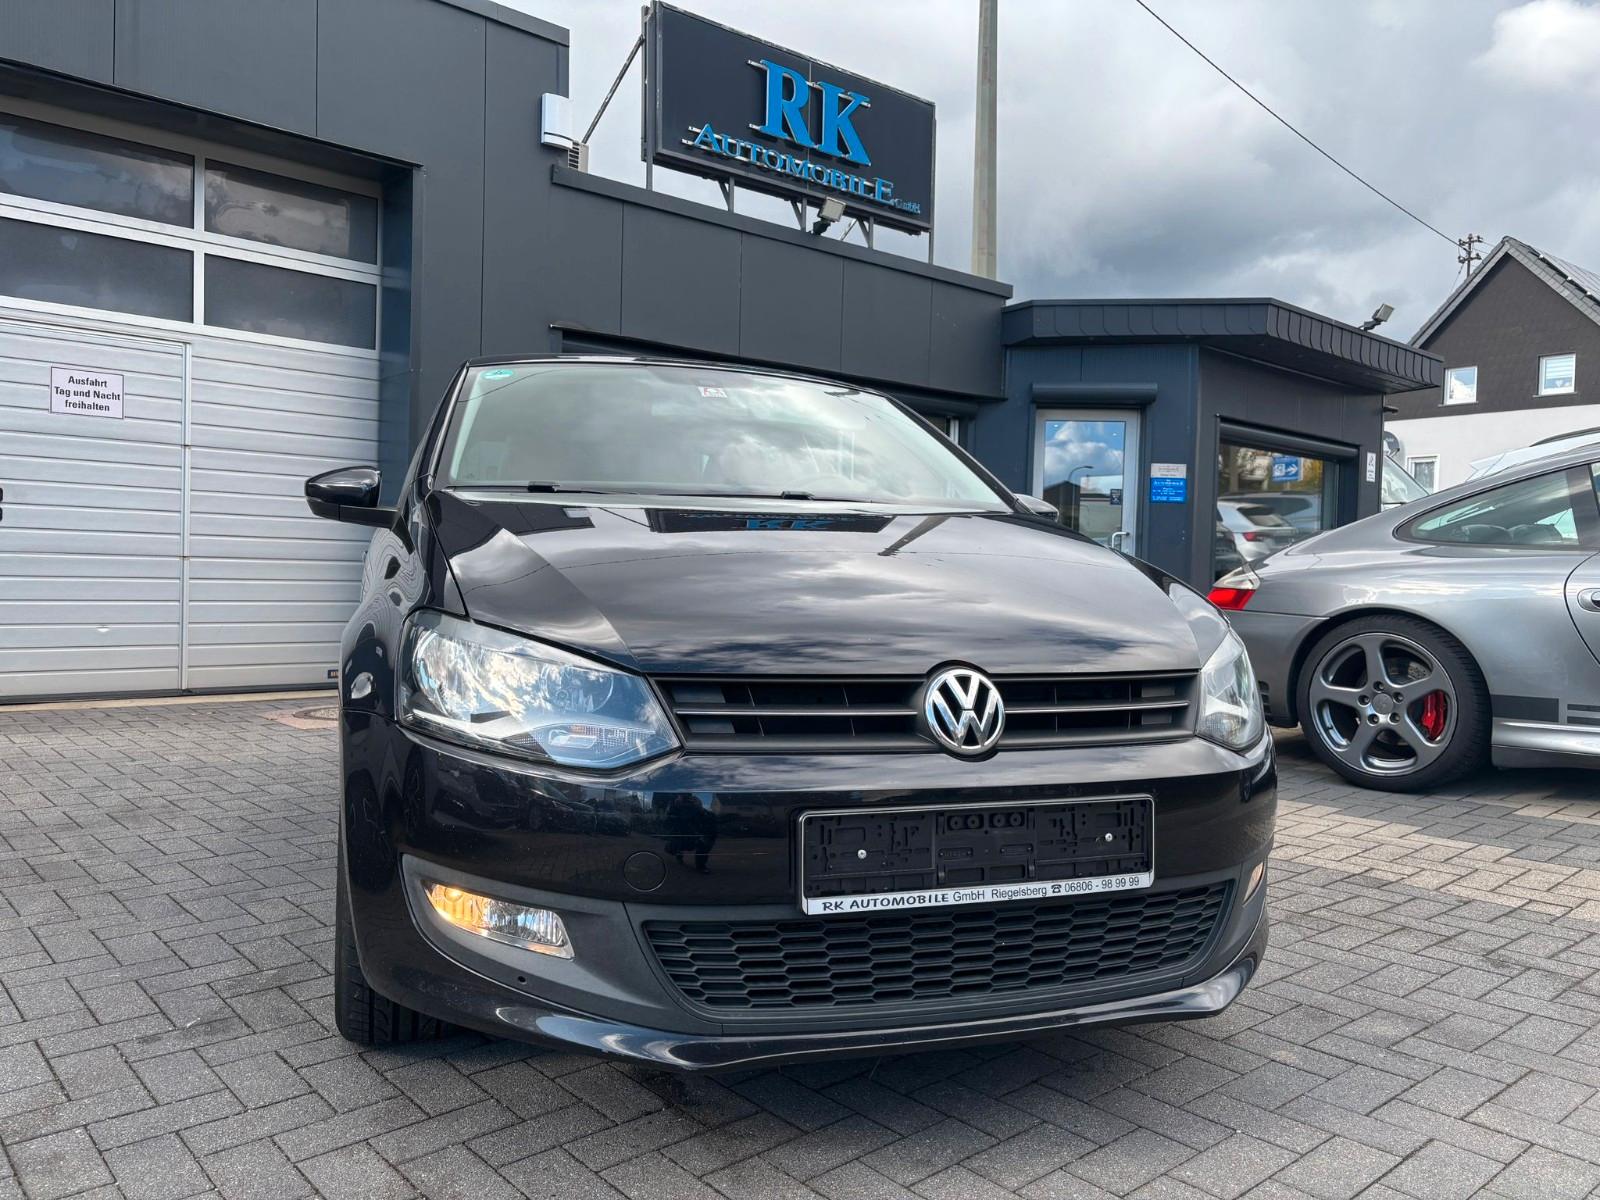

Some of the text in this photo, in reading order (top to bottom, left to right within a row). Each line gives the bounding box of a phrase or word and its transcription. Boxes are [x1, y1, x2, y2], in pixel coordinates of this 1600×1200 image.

[755, 59, 871, 166] RK
[68, 375, 108, 388] Ausfahrt
[54, 386, 121, 401] Tag und Nacht
[65, 399, 110, 412] freihalten
[822, 901, 845, 911] RK
[850, 893, 949, 909] AUTOMOBILE
[953, 890, 985, 902] GmbH
[991, 886, 1047, 900] Riegelsberg
[1064, 880, 1093, 893] 06806
[1101, 879, 1113, 889] 98
[1115, 877, 1127, 888] 99
[1128, 876, 1140, 886] 99
